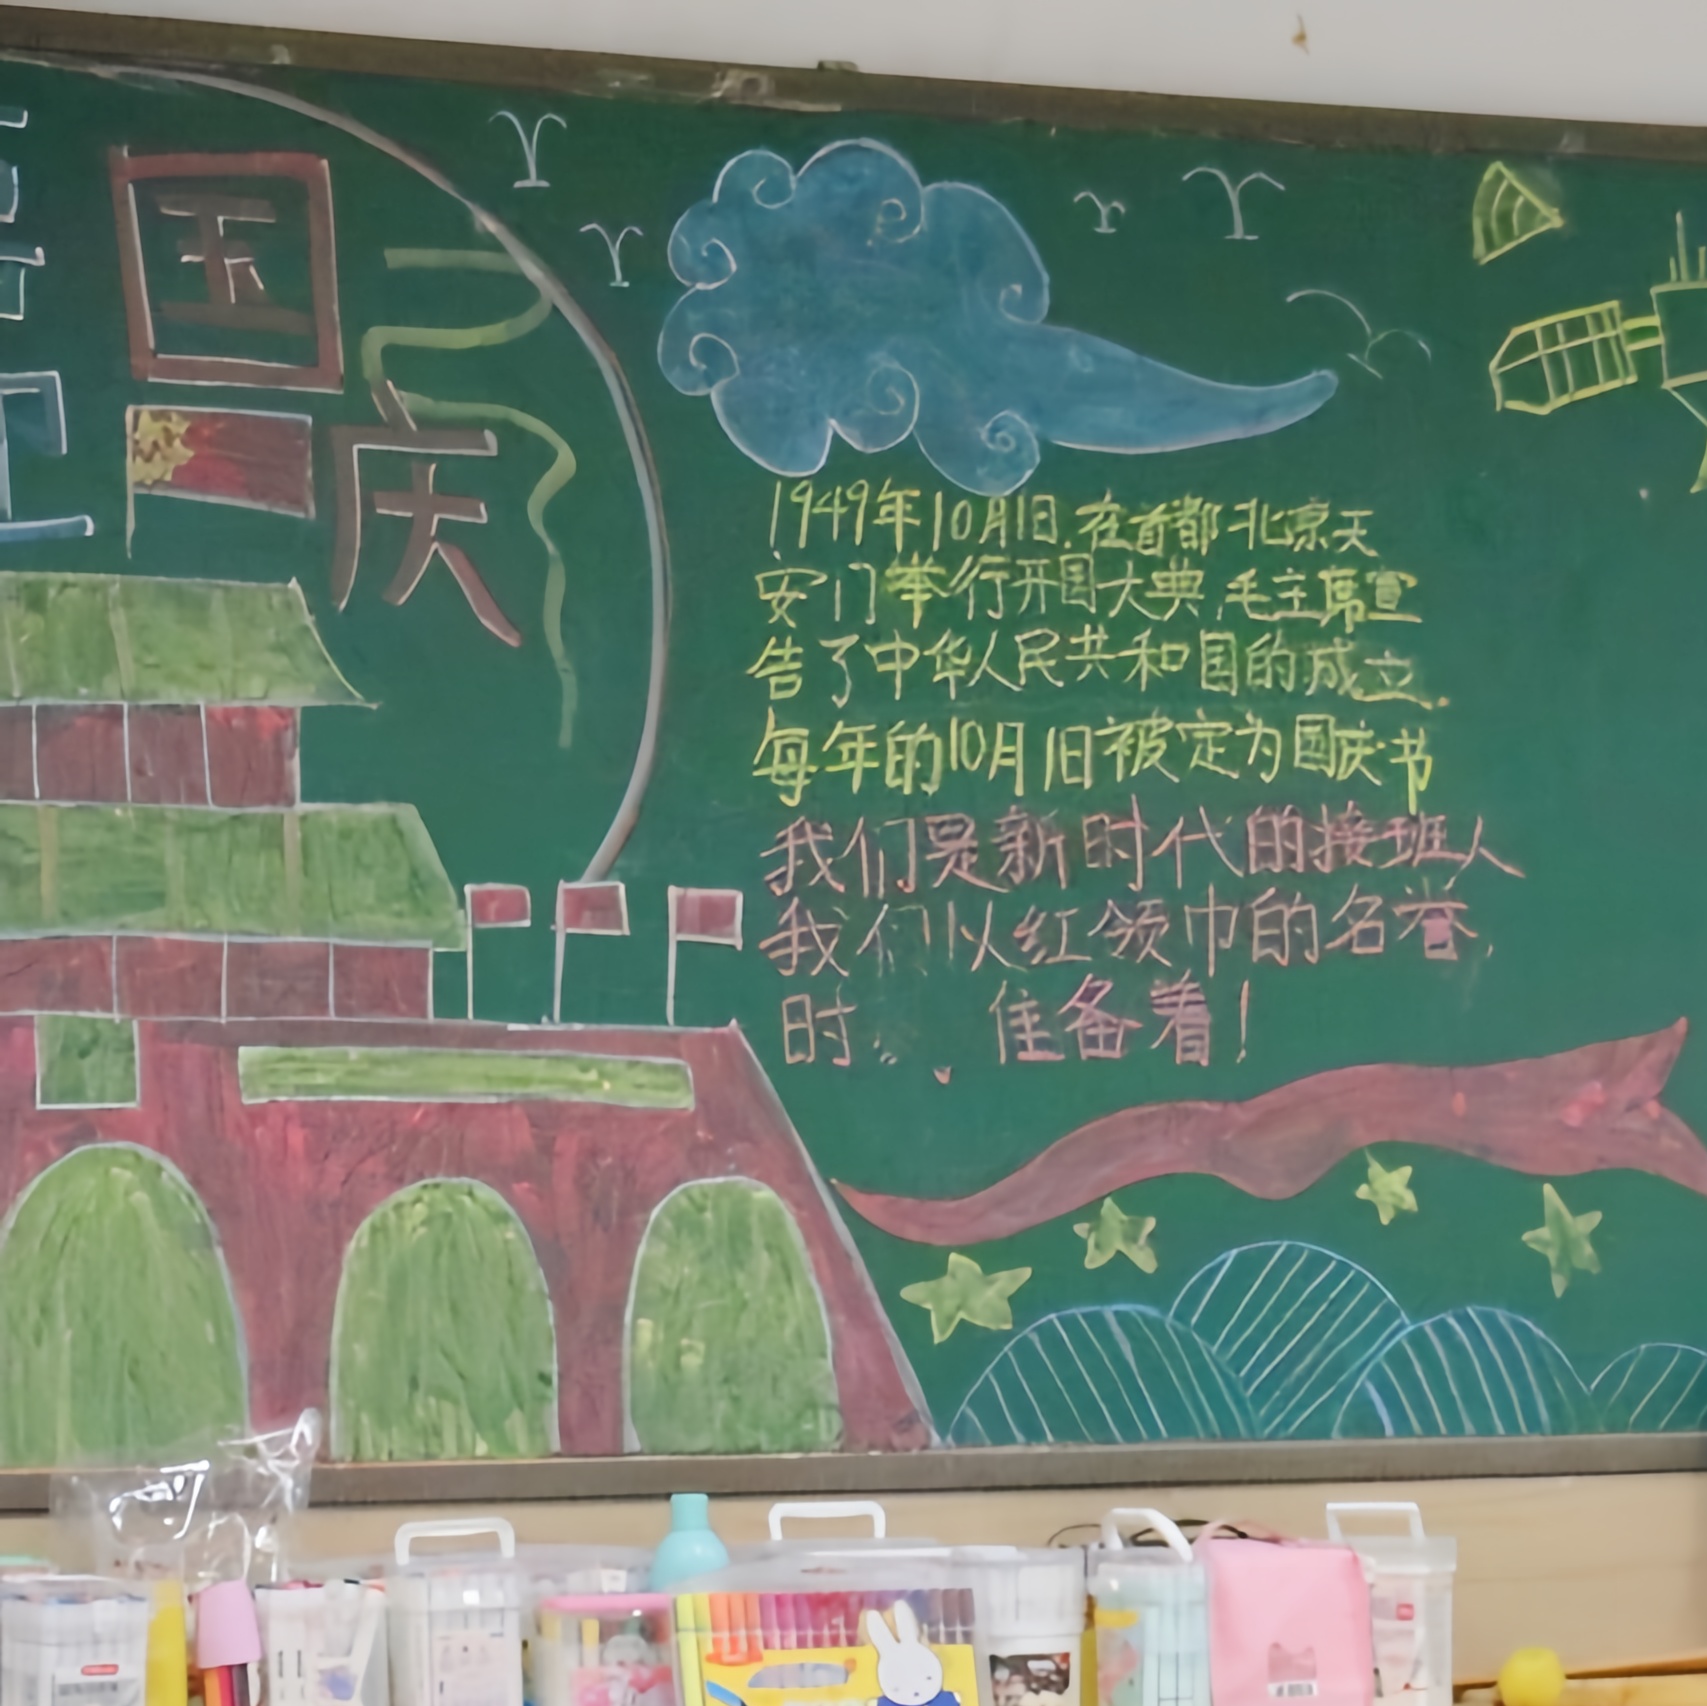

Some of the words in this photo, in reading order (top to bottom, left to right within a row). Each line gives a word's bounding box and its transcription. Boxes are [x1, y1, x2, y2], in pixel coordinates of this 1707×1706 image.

[759, 793, 1526, 898] 我们是新时代的接班人
